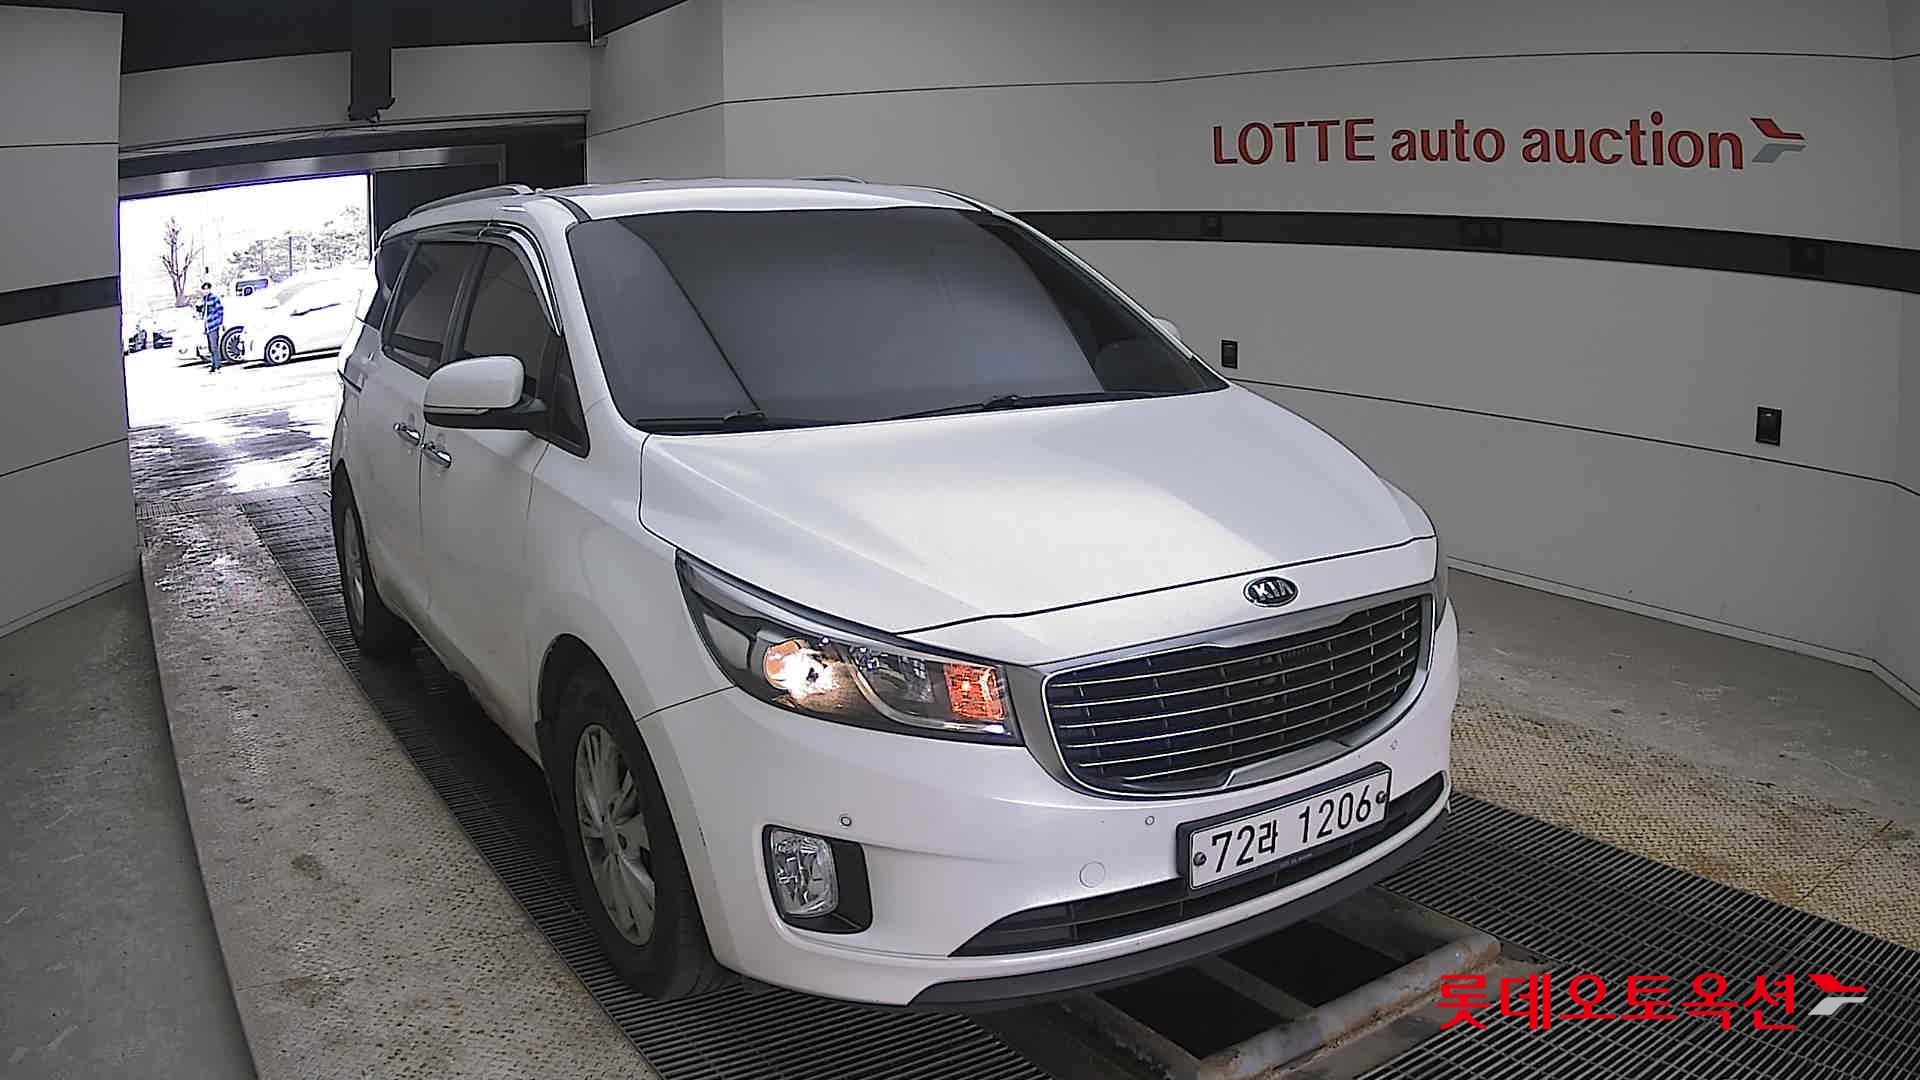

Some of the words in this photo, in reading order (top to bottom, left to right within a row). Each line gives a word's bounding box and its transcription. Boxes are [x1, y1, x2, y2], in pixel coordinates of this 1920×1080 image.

[1213, 117, 1376, 164] LOTTE
[1391, 119, 1506, 163] auto
[1522, 111, 1744, 170] auction
[1251, 580, 1294, 601] KIA
[1211, 819, 1279, 874] 72라
[1299, 784, 1371, 844] 1206
